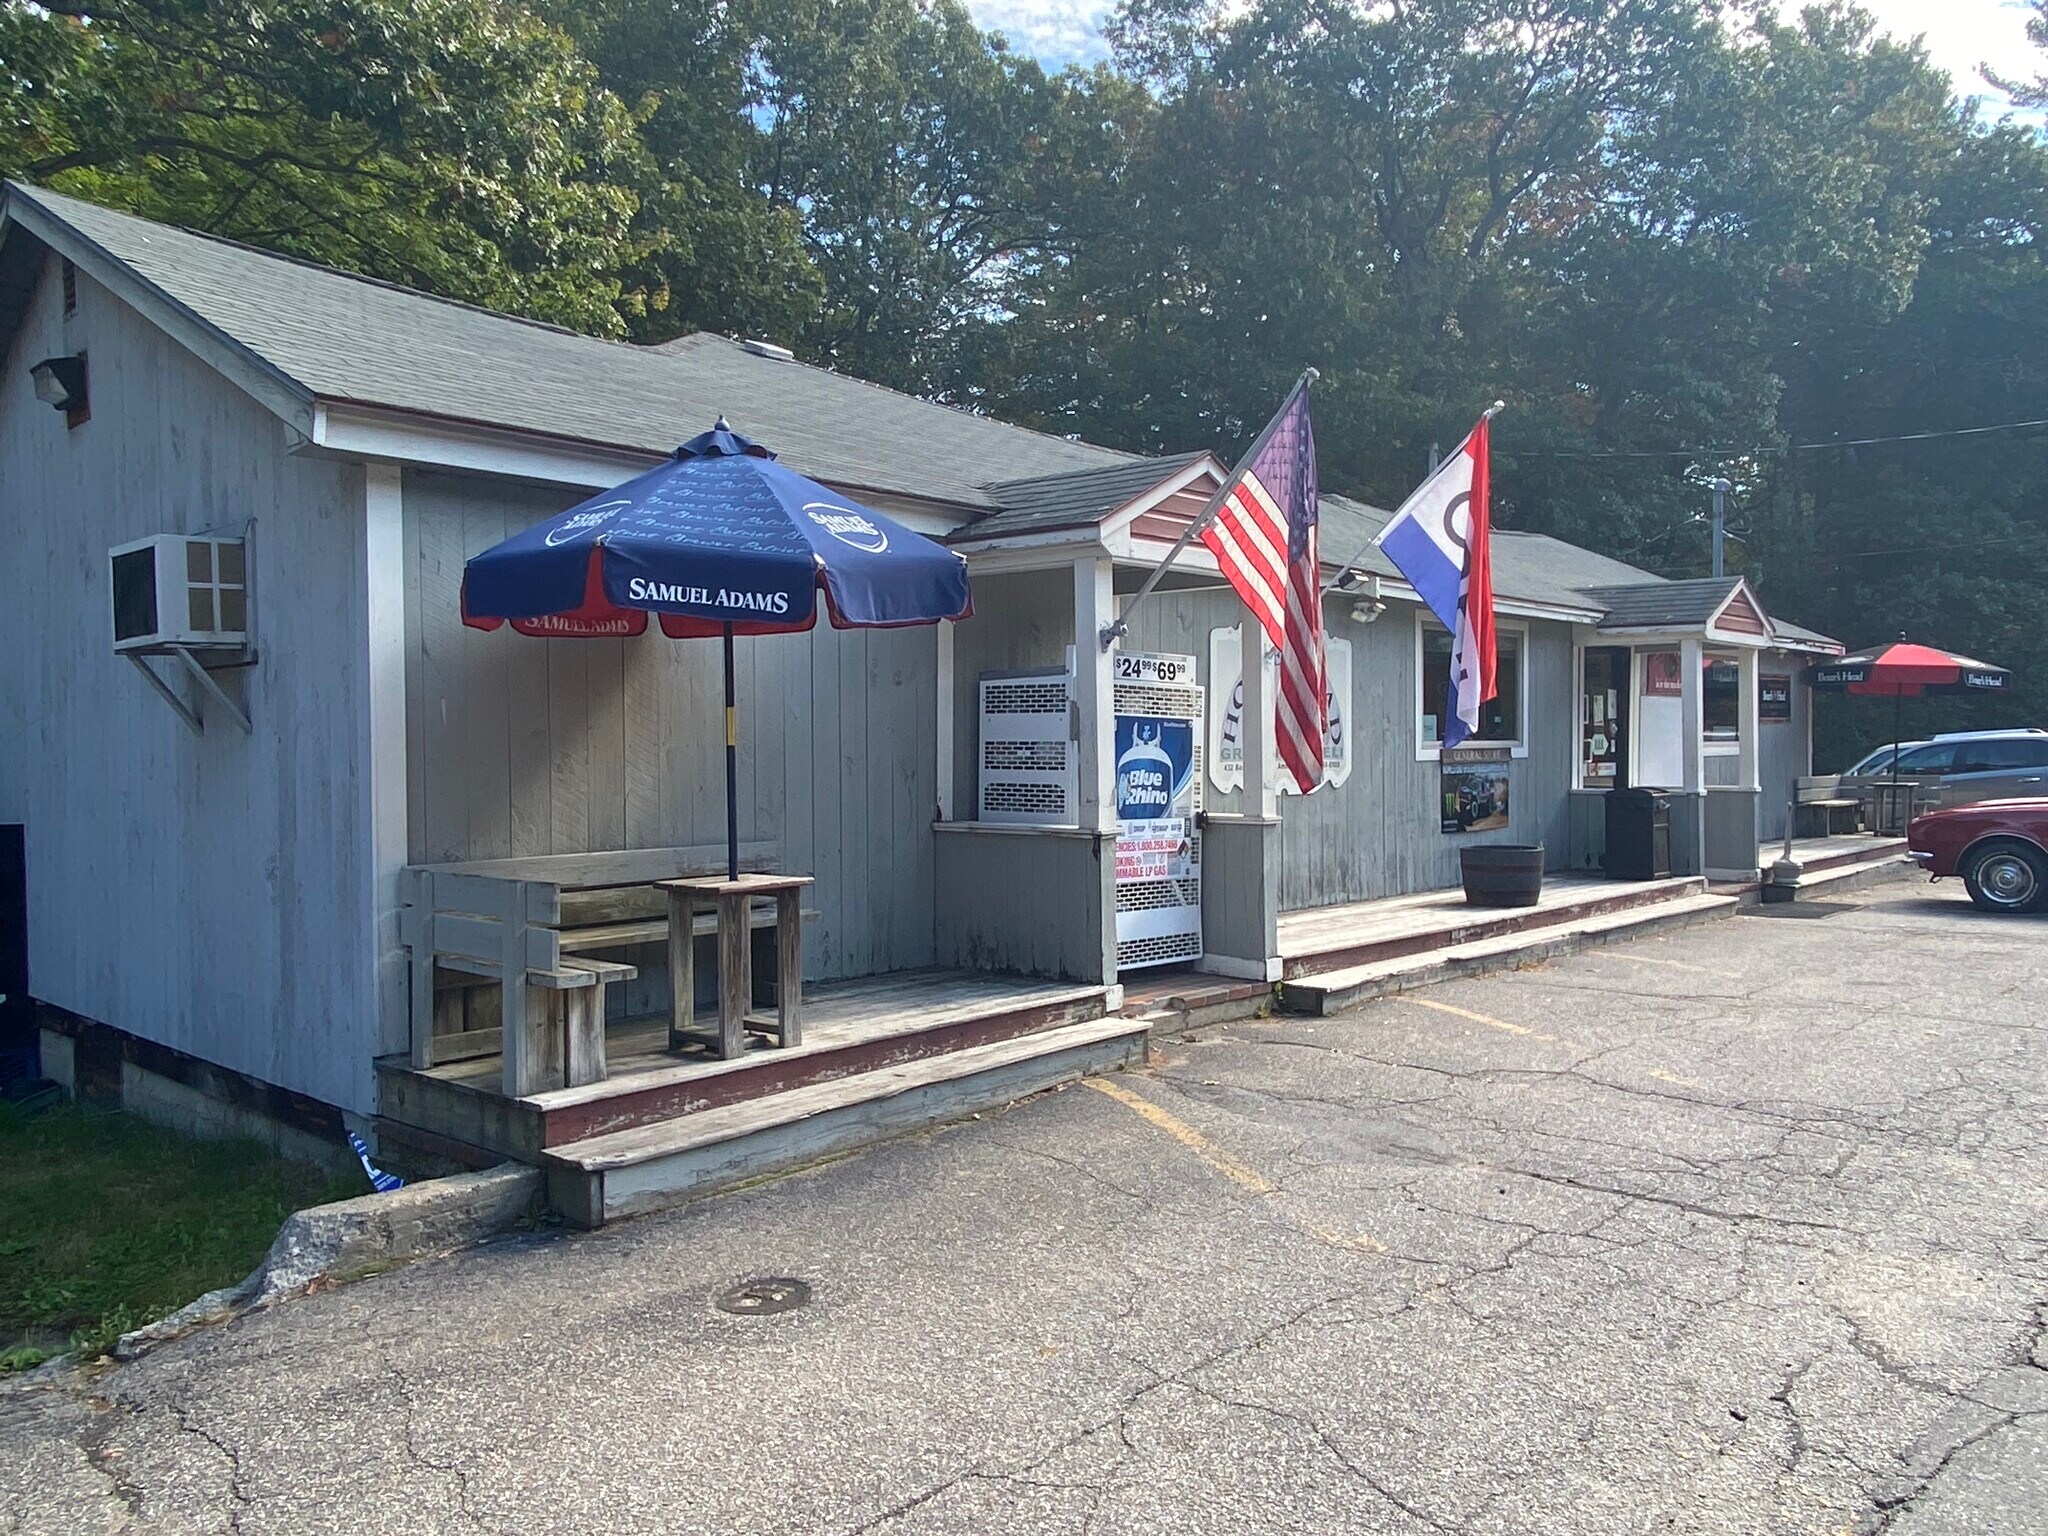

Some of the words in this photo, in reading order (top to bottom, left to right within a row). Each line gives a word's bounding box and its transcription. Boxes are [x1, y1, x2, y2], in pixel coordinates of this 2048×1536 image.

[665, 533, 735, 548] Brewer
[739, 540, 806, 554] Patriot
[629, 577, 712, 605] SAMUEL
[714, 588, 789, 614] ADAMS
[525, 615, 590, 633] SAMUEL
[1842, 671, 1864, 682] Head
[1984, 675, 2003, 687] Head
[1453, 750, 1482, 761] GENERAL
[1129, 768, 1163, 787] Blue
[1125, 786, 1168, 805] Rhino
[1153, 864, 1167, 876] GAS
